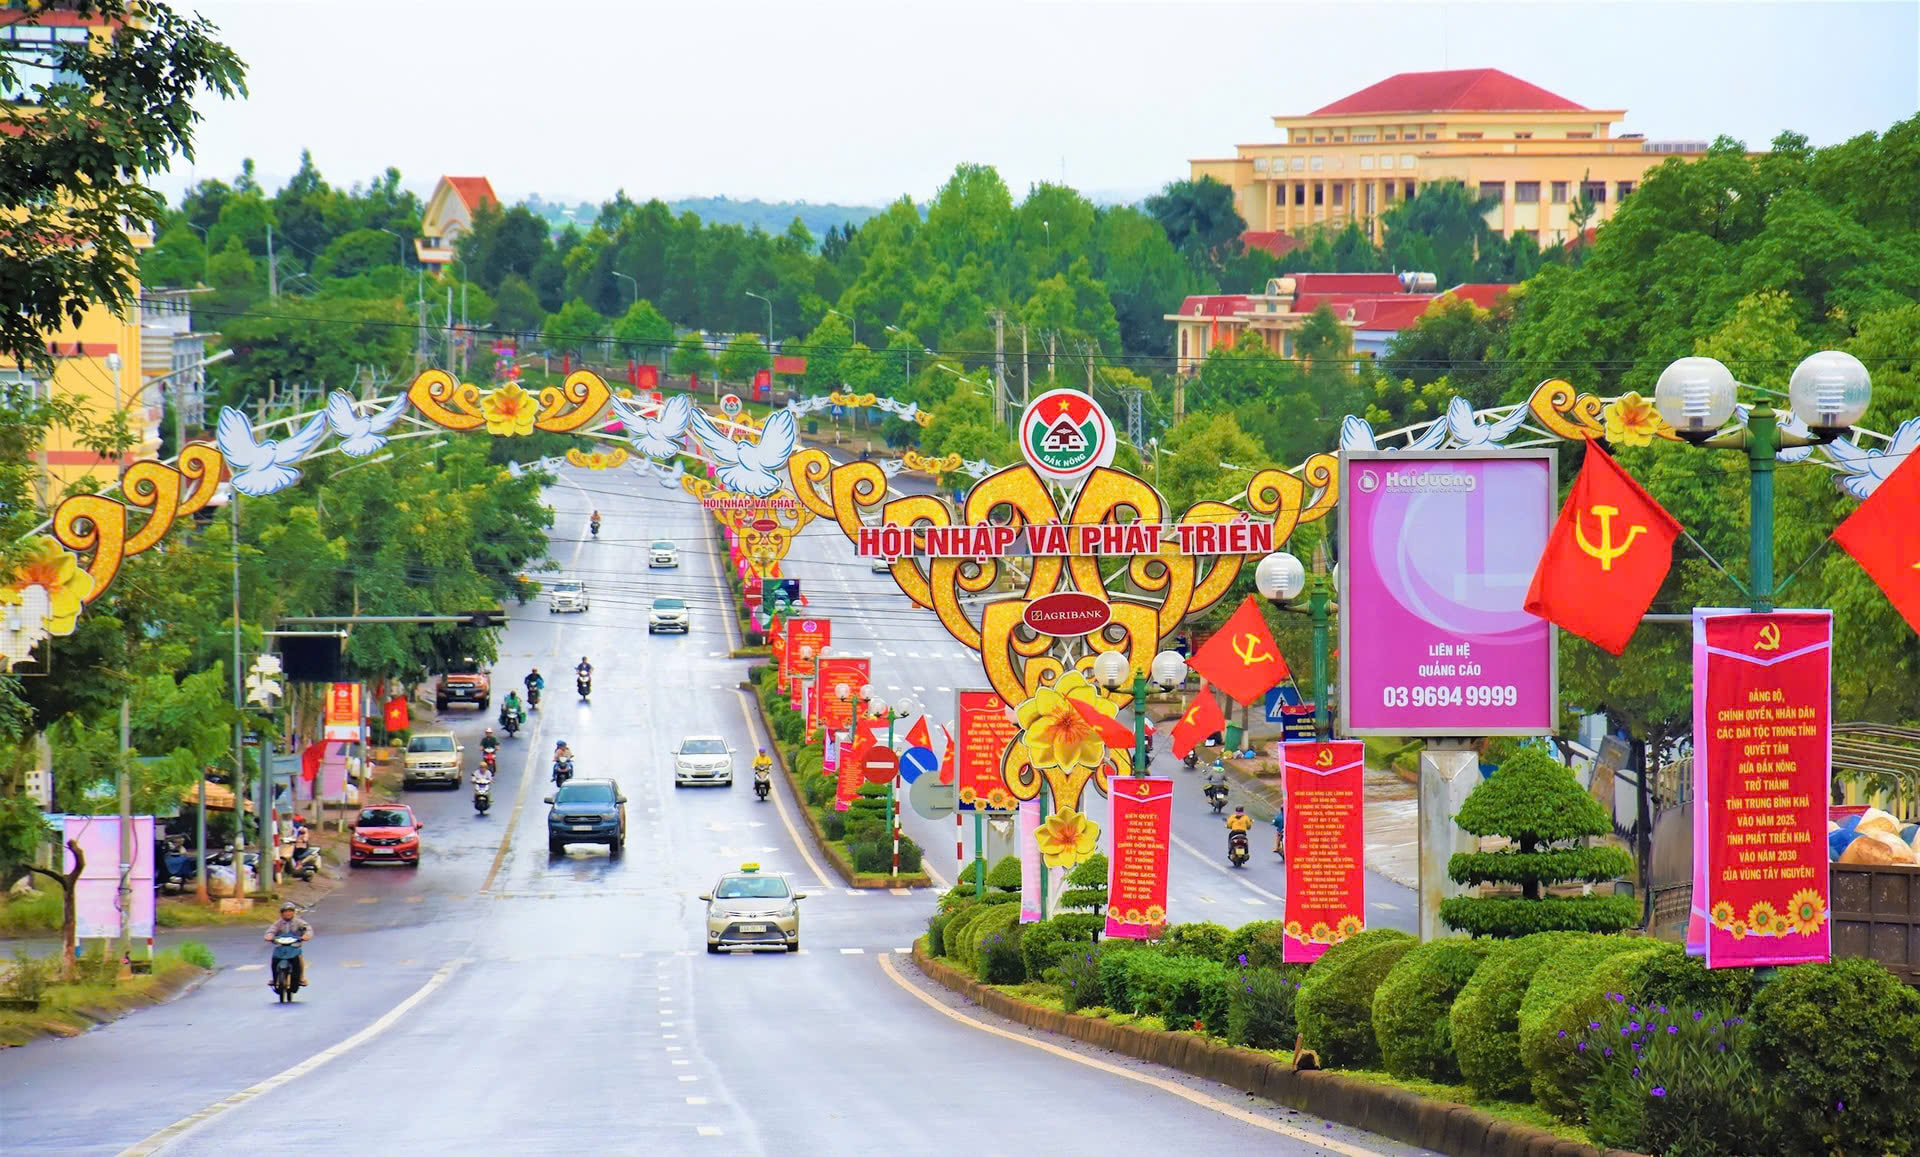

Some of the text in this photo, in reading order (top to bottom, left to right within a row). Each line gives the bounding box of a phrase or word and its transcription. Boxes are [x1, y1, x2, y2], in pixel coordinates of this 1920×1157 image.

[1064, 453, 1086, 466] NÔNG
[859, 513, 1274, 563] HỘI NHẬP VÀ PHÁT TRIỂN
[1043, 610, 1102, 620] AGRIBANK
[1429, 642, 1470, 659] LIÊN HỆ
[1418, 661, 1481, 677] QUẢNG CÁO
[1383, 685, 1518, 707] 03 9694 9999
[1749, 688, 1785, 703] ĐẢNG BỘ,
[1718, 705, 1816, 721] CHÍNH QUYỀN, NHÂN DÂN
[1717, 722, 1816, 739] CÁC DÂN TỘC TRONG TỈNH
[1744, 741, 1789, 757] QUYẾT TÂM
[1739, 758, 1796, 774] ĐƯA ĐẮK NÔNG
[1745, 776, 1789, 791] TRỞ THÀNH
[1726, 793, 1810, 810] TỈNH TRUNG BÌNH KHÁ
[1737, 813, 1797, 827] VÀO NĂM 2025,
[1727, 827, 1811, 846] TỈNH PHÁT TRIỂN KHÁ
[1739, 848, 1797, 863] VÀO NĂM 2030
[1723, 864, 1815, 881] CỦA VÙNG TÂY NGUYÊN!
